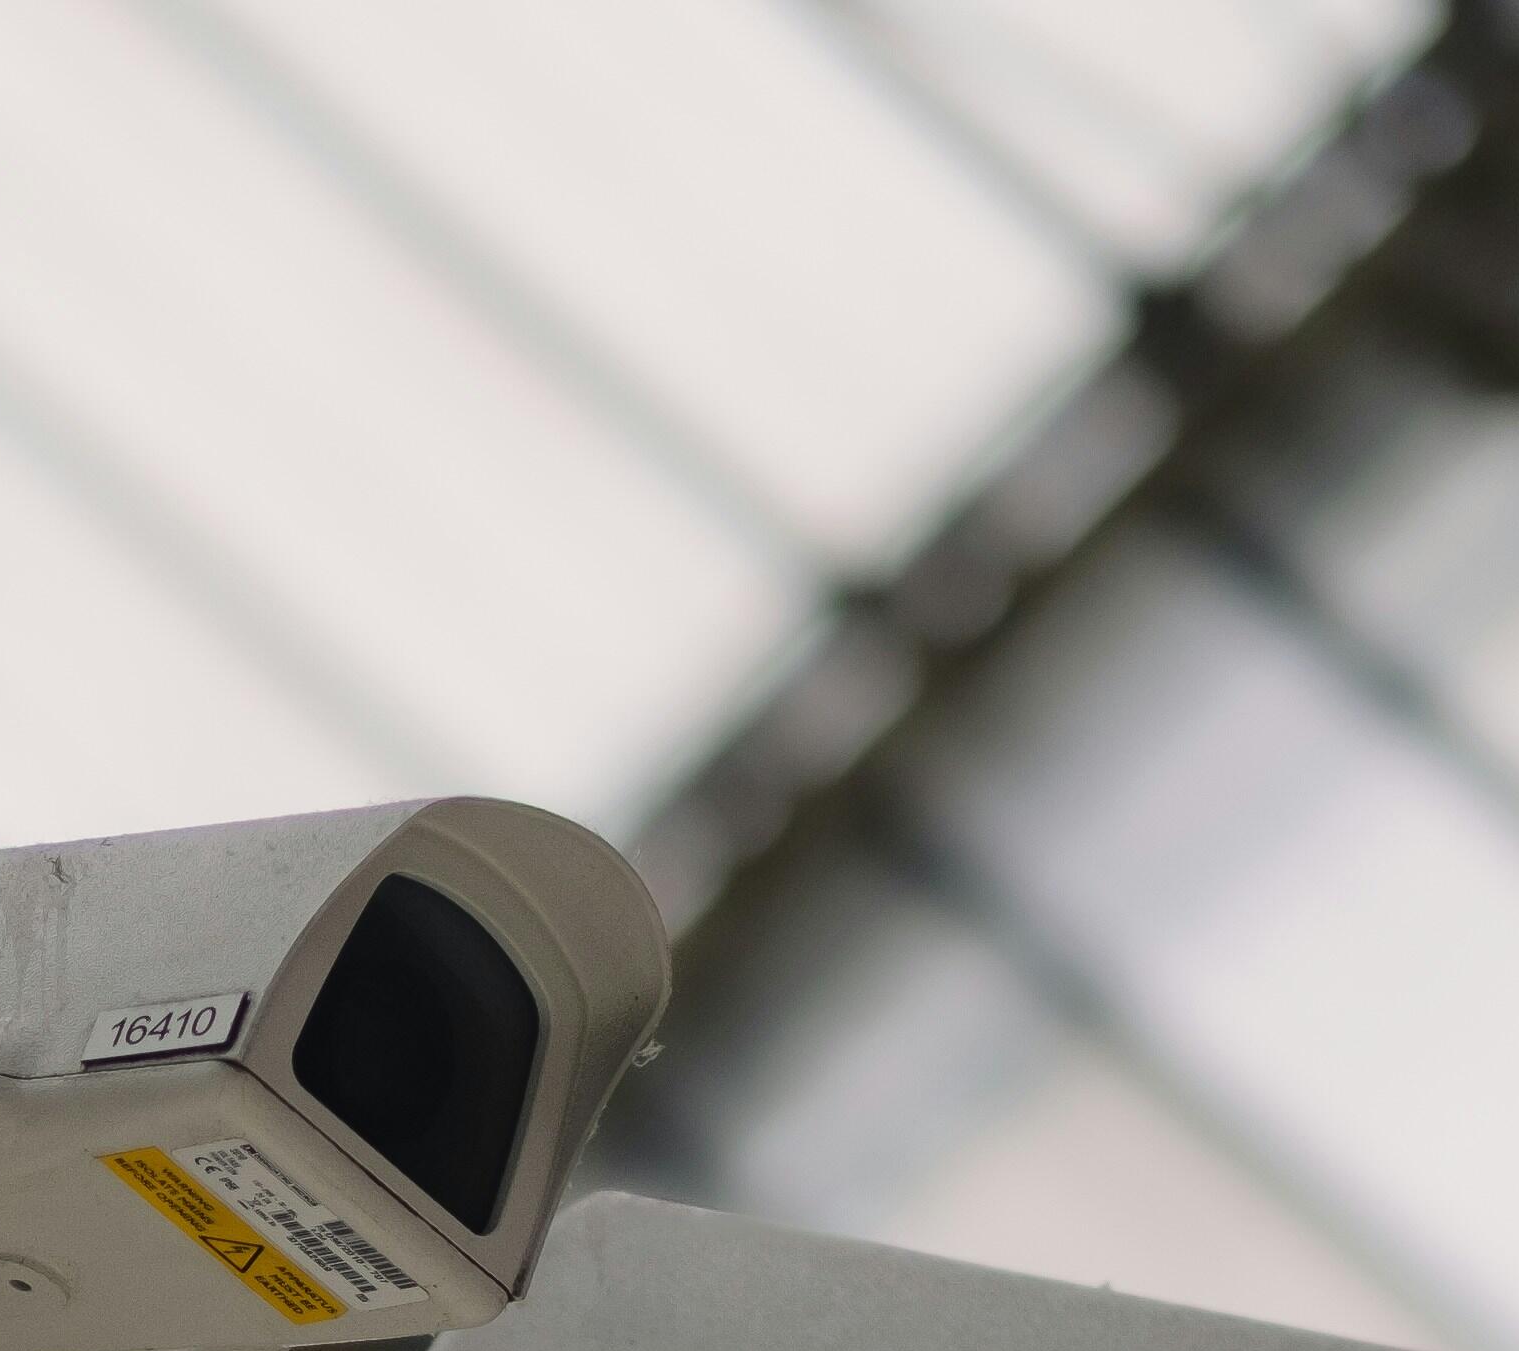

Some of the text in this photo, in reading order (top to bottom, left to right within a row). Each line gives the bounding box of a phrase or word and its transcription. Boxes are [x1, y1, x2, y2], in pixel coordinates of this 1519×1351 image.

[112, 1006, 217, 1047] 16410
[113, 1157, 158, 1192] BEFORE
[155, 1192, 208, 1232] OPENING
[134, 1159, 179, 1196] ISOLATE
[176, 1196, 216, 1225] MAINS
[161, 1168, 216, 1211] WARNING
[268, 1273, 302, 1297] MUST
[275, 1265, 339, 1314] APPARATUS
